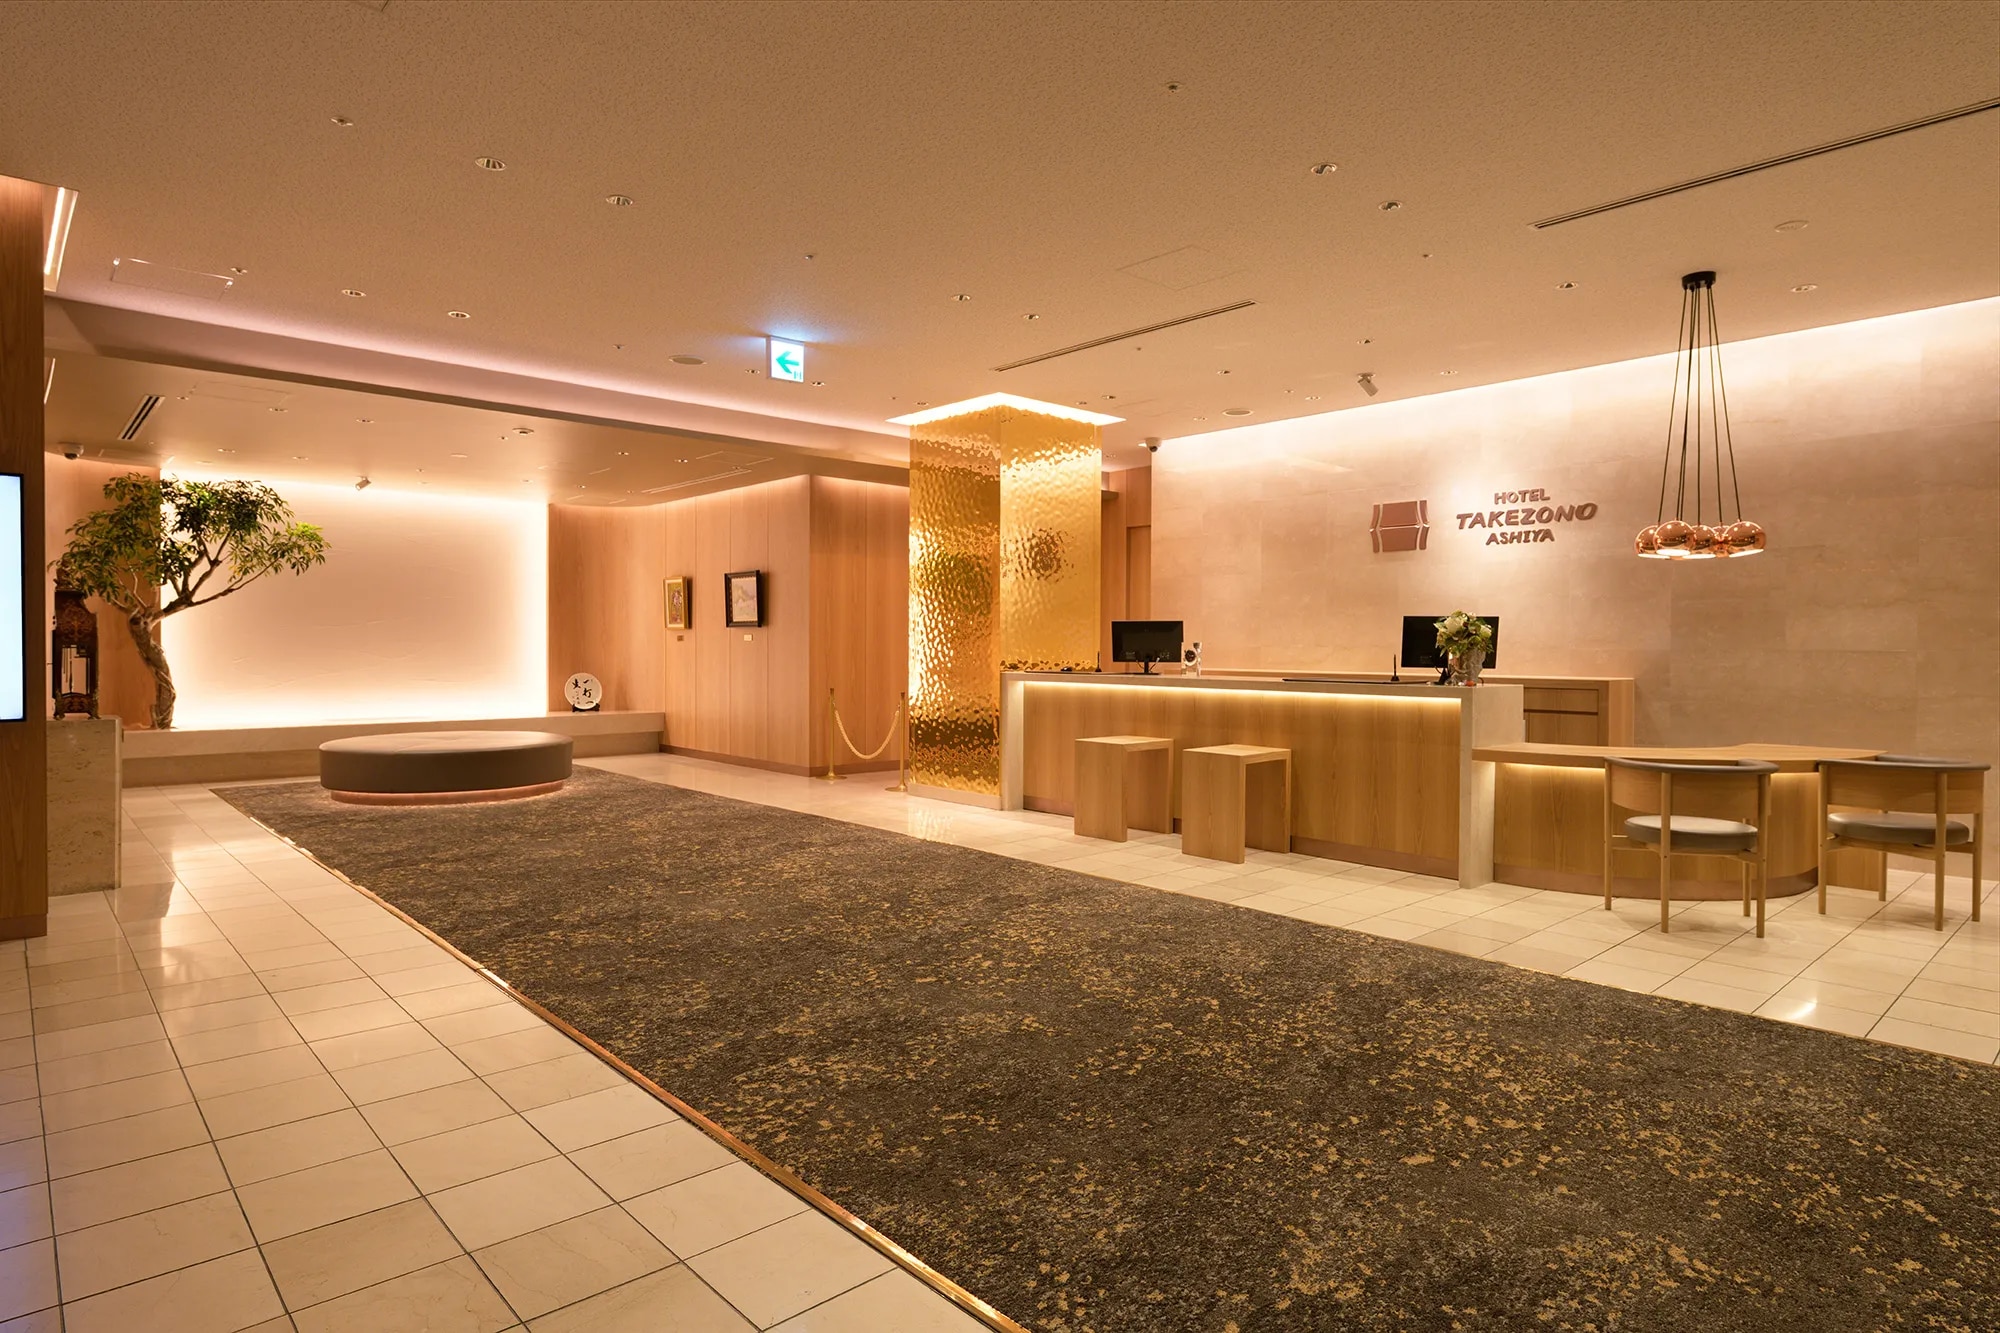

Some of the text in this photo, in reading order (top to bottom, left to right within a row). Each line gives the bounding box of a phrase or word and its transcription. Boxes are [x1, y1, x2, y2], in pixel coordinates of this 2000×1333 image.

[1494, 488, 1551, 505] HOTEL
[1456, 502, 1598, 530] TAKEZONO
[1485, 528, 1555, 546] ASHIYA
